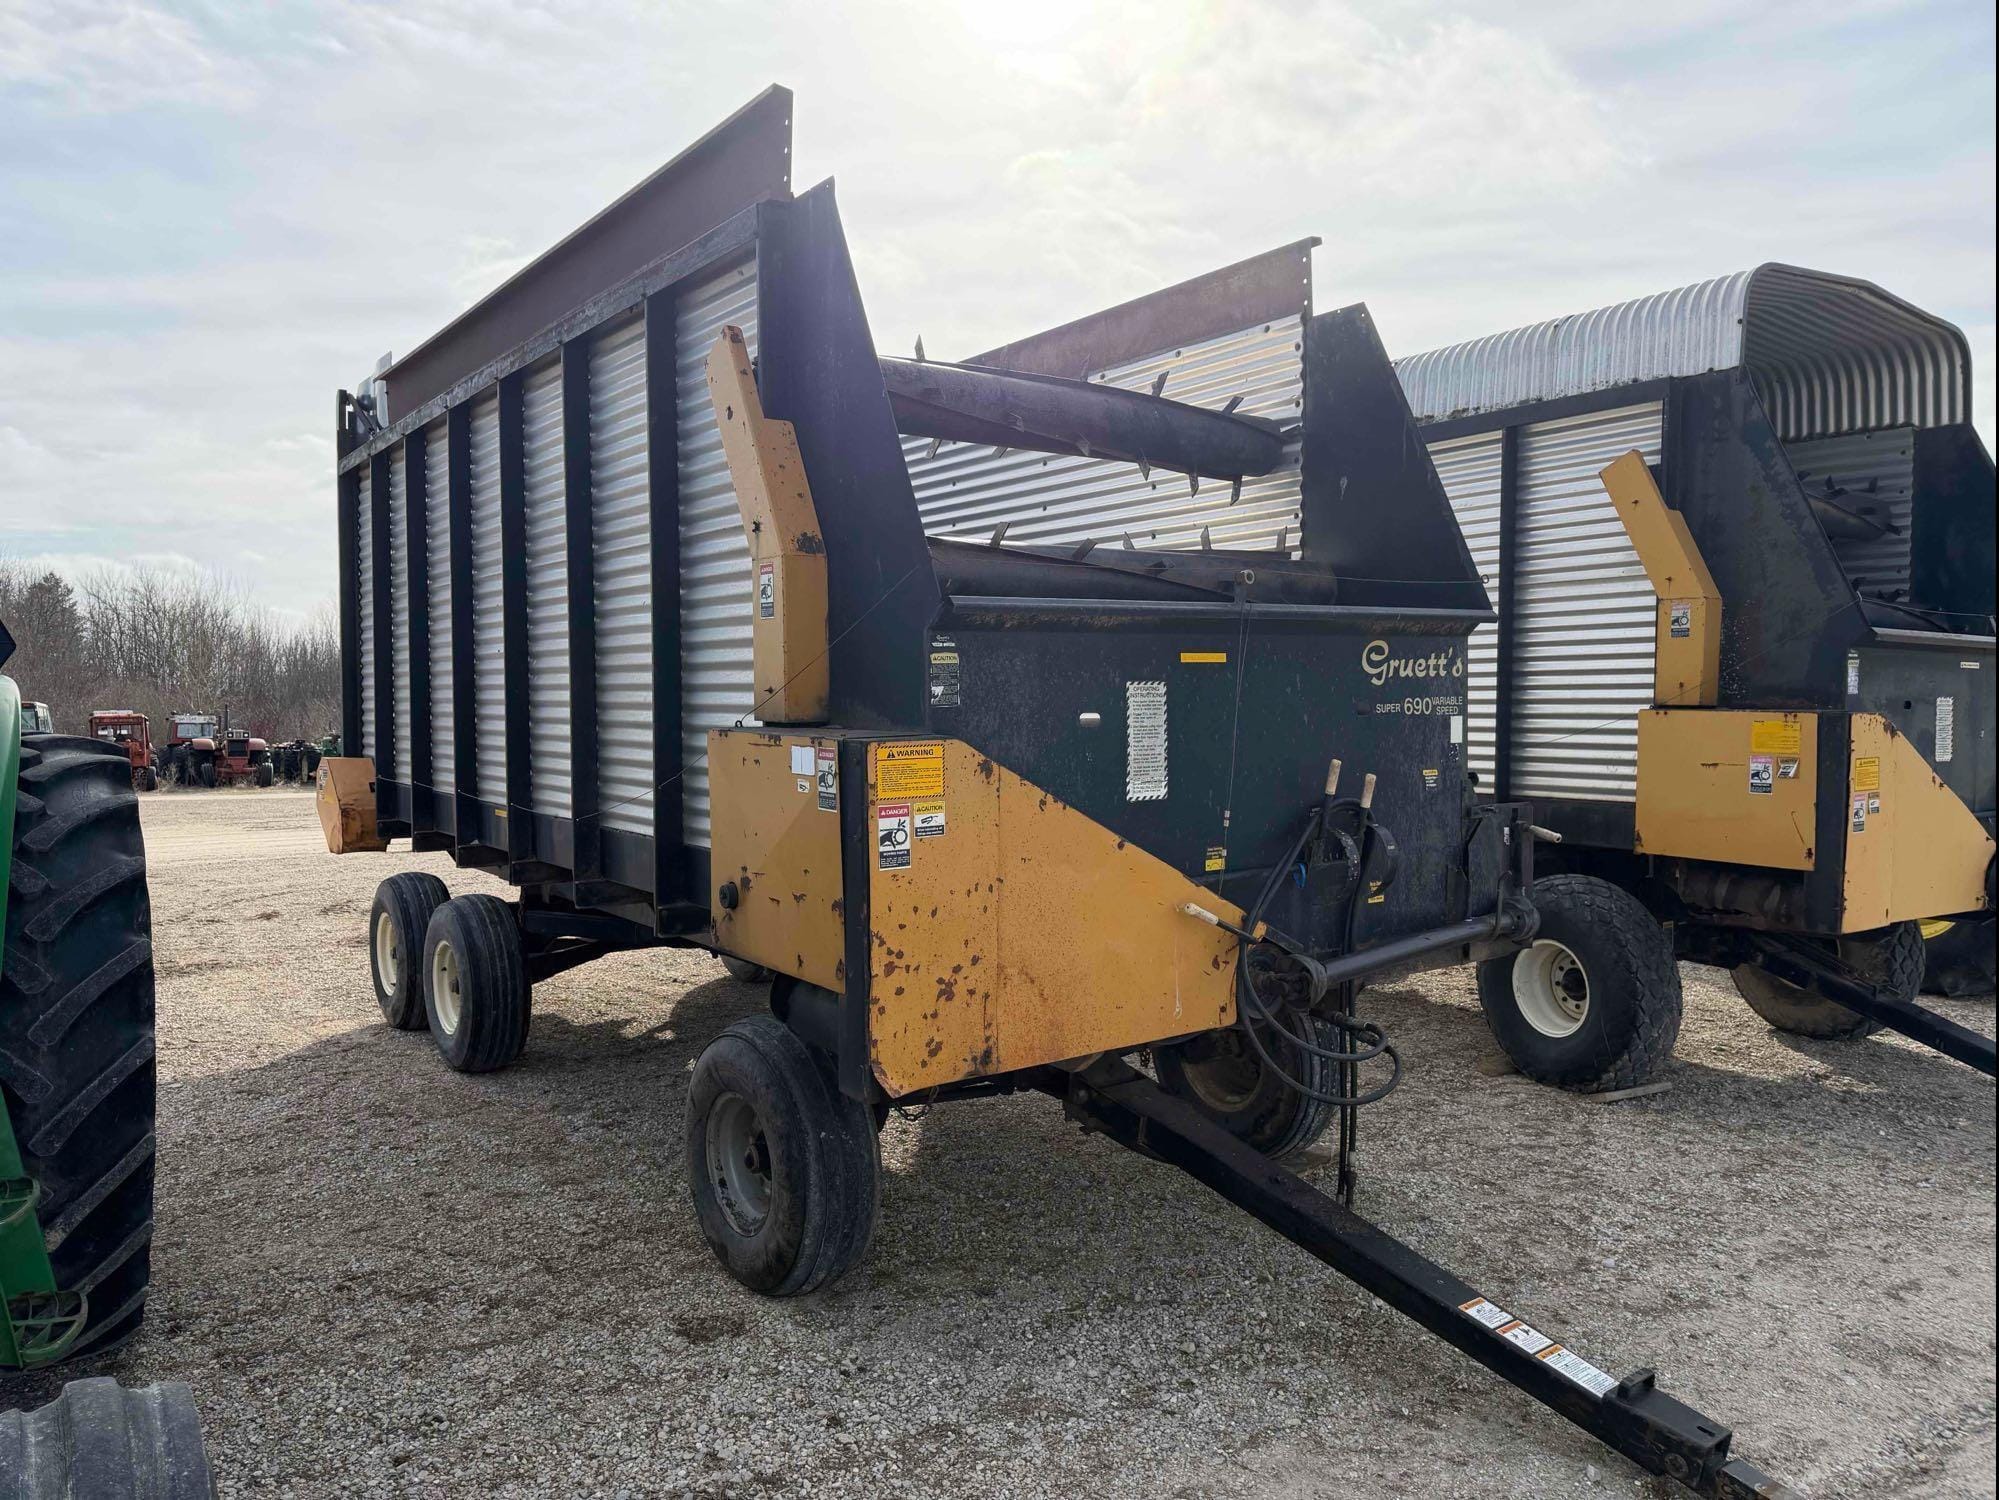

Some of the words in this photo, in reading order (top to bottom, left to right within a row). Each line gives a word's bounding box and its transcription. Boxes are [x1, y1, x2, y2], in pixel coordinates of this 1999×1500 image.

[1362, 640, 1463, 686] Gruett's
[1431, 696, 1463, 705] VARIABLE
[1376, 703, 1401, 714] SUPER
[1404, 697, 1432, 715] 690
[1436, 706, 1459, 715] SPEED
[896, 748, 934, 757] WARNING
